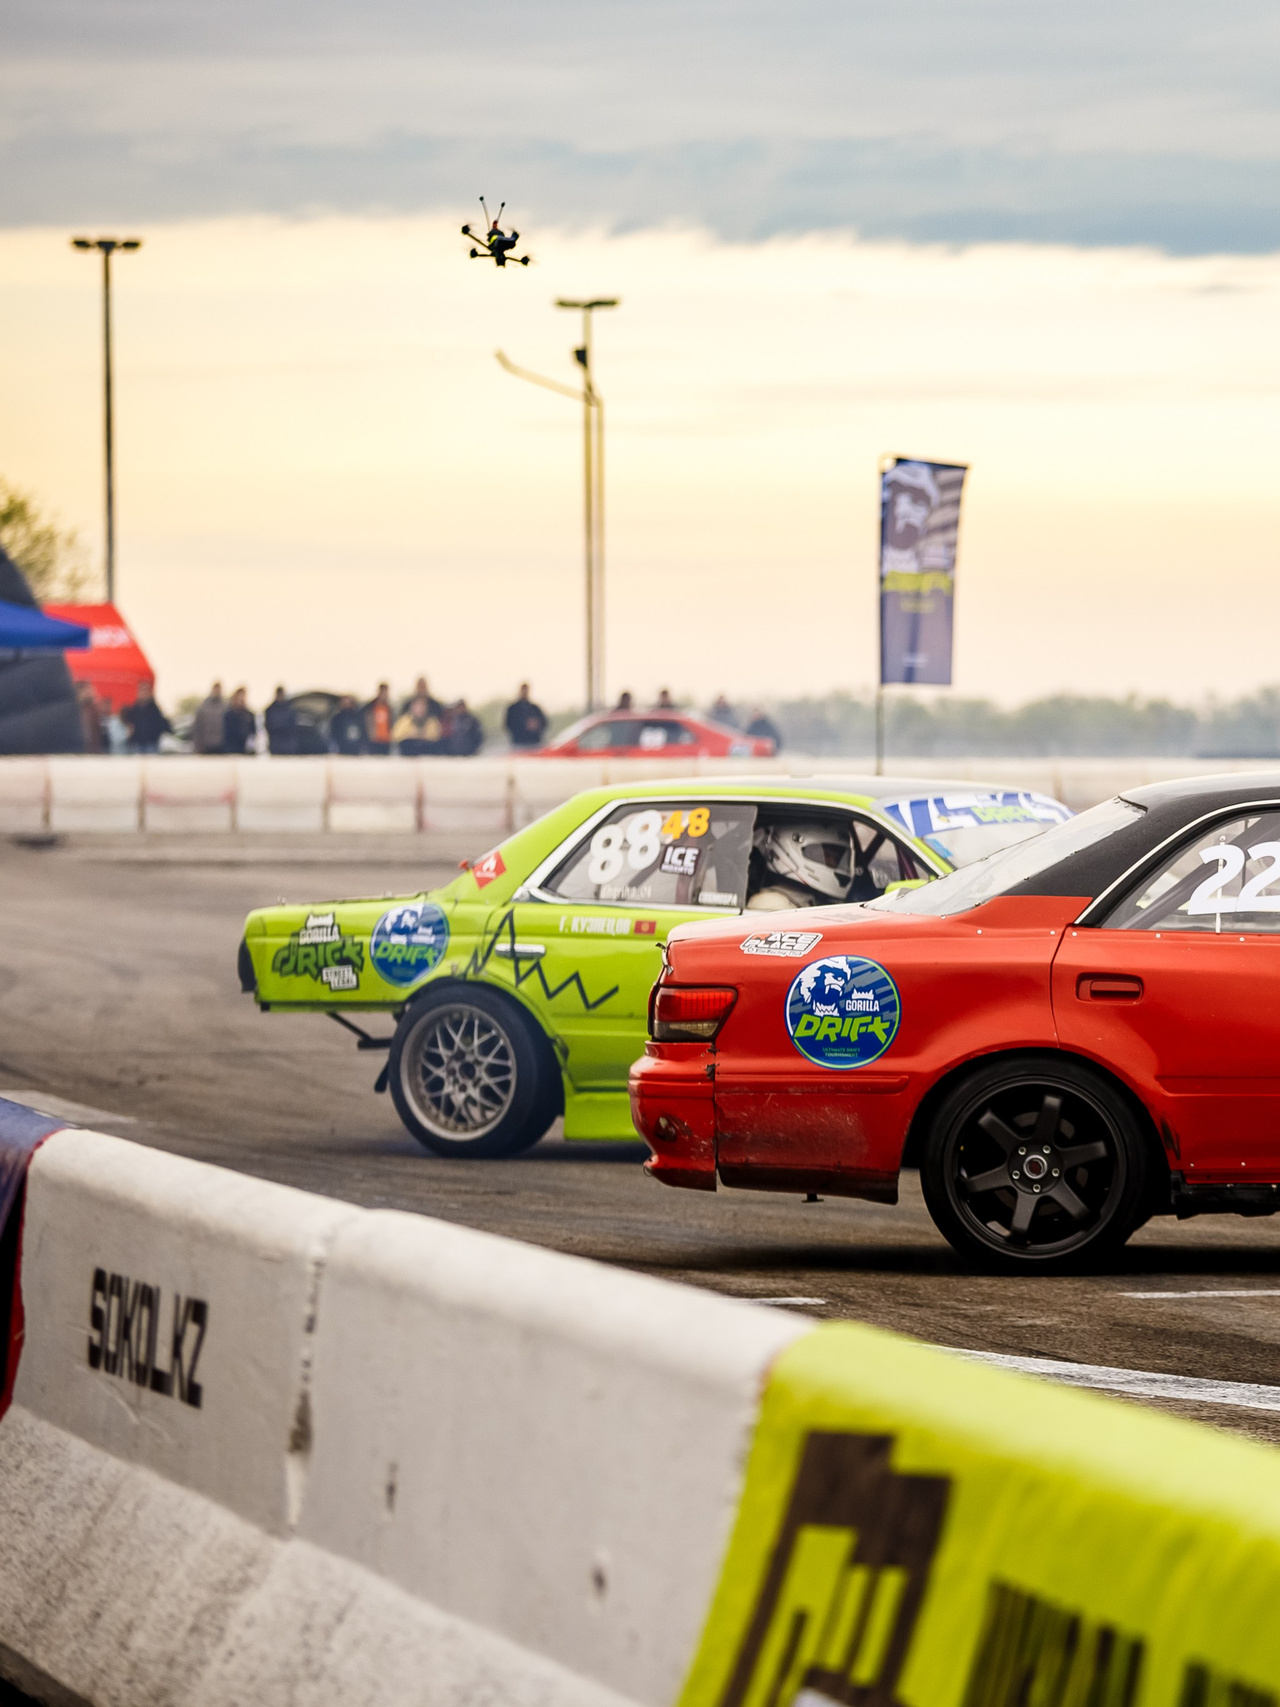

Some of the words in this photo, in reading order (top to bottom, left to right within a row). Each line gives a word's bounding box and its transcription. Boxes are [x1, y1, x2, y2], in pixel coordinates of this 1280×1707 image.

[662, 807, 710, 840] 48
[588, 809, 662, 885] 88
[664, 845, 699, 867] ICE
[745, 940, 810, 951] PLACE
[751, 933, 819, 943] RACE
[845, 1000, 880, 1012] GORILLA
[794, 1013, 890, 1045] DRIFT
